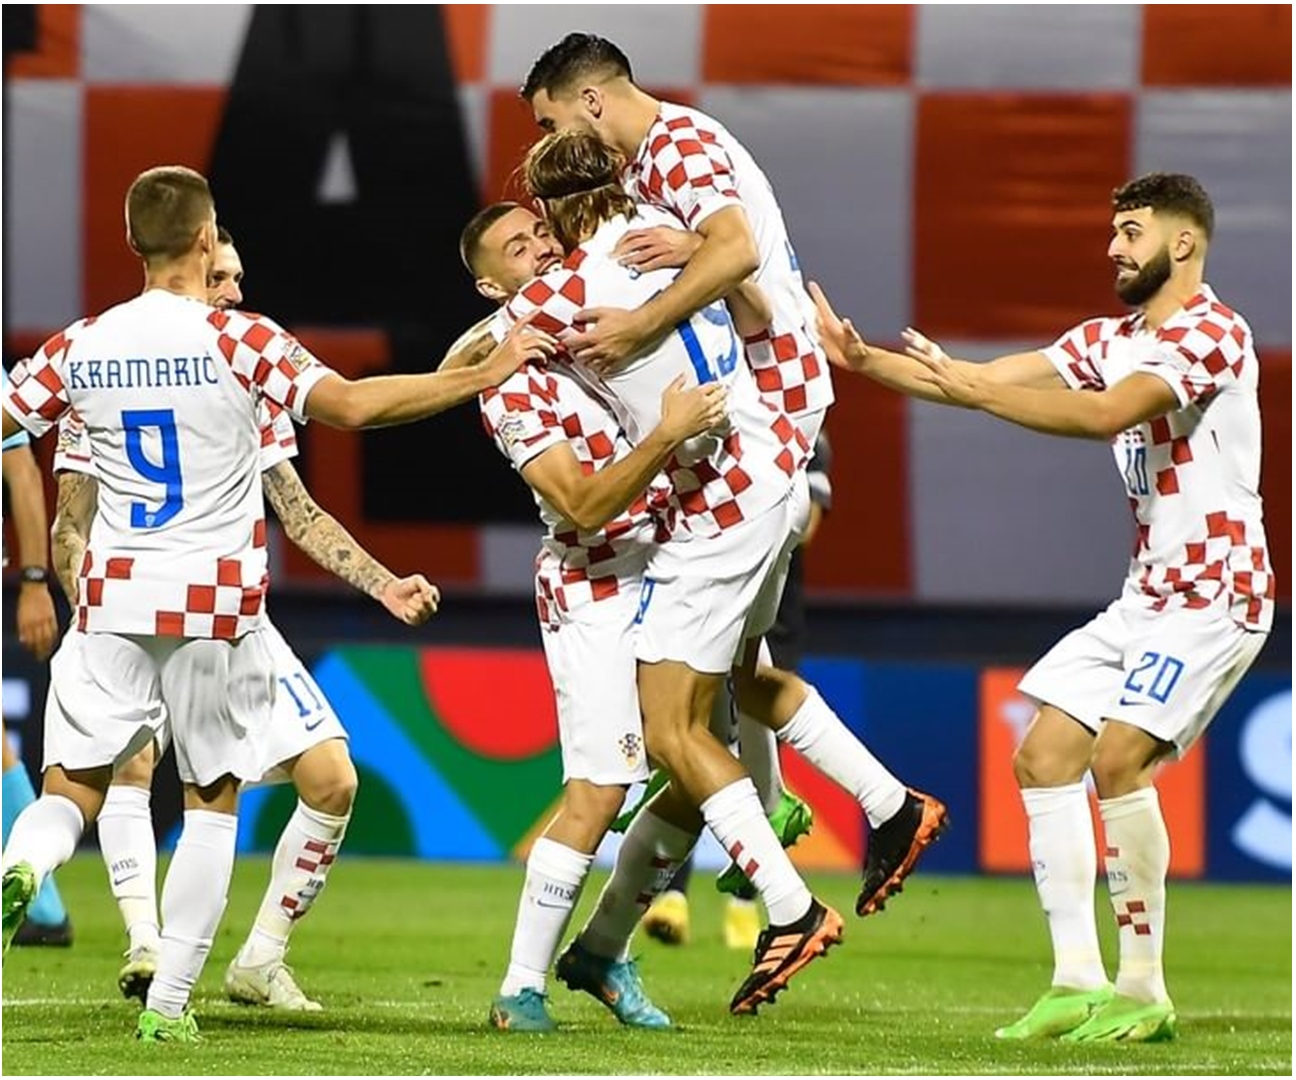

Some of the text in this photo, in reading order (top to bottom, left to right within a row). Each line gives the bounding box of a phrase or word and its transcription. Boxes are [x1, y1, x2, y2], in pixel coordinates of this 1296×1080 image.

[121, 409, 183, 528] 9
[279, 672, 323, 717] 11
[1125, 651, 1184, 703] 20
